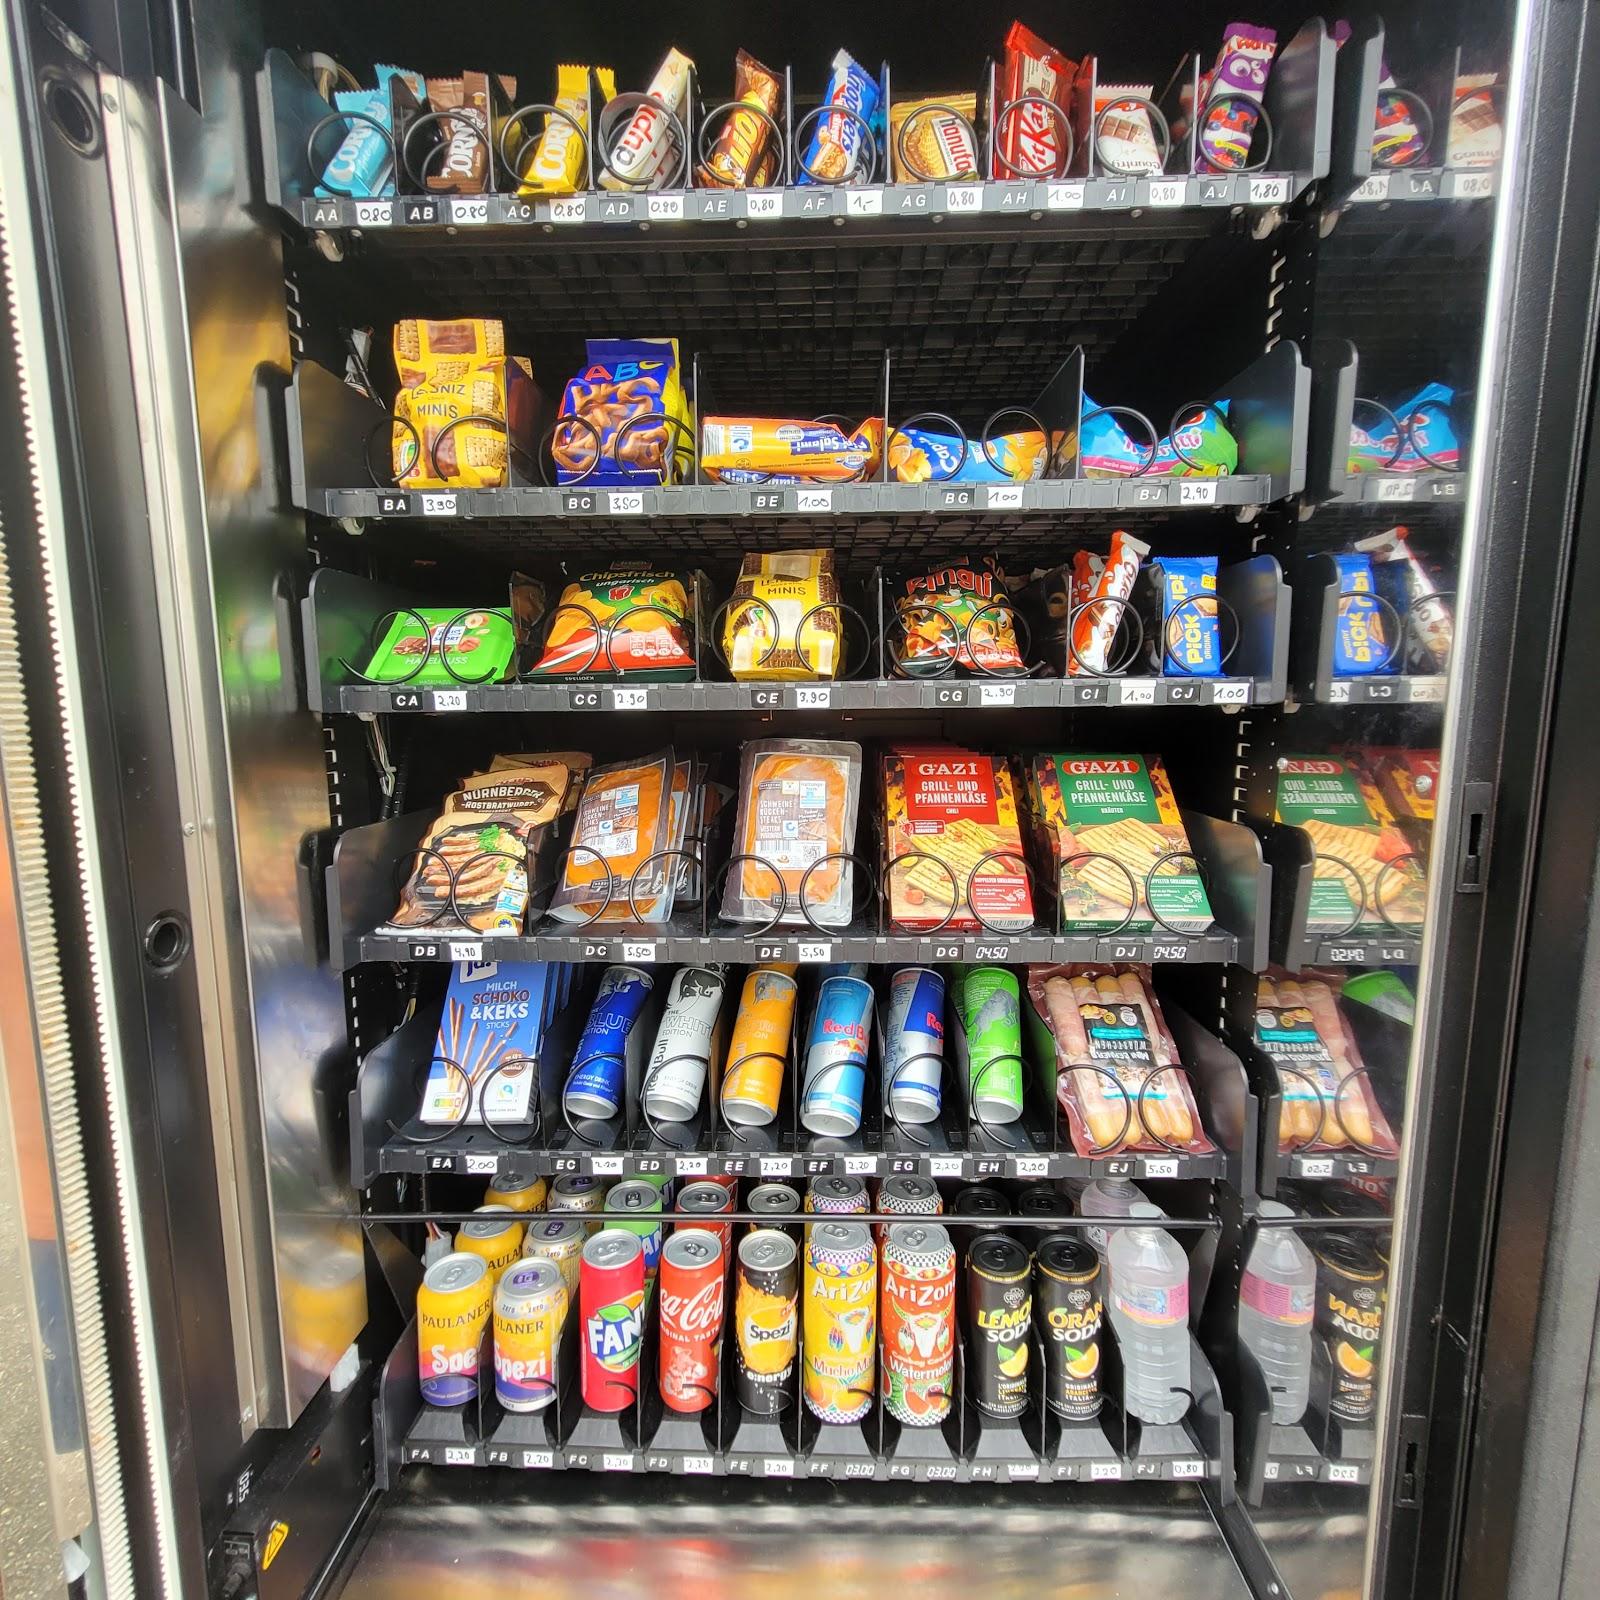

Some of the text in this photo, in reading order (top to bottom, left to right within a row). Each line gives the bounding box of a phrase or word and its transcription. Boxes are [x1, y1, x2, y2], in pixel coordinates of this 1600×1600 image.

[939, 116, 972, 173] hanuta
[1106, 189, 1127, 202] AI
[1204, 187, 1229, 200] AJ
[1251, 183, 1281, 199] 1,80
[902, 194, 927, 208] AG
[1002, 191, 1029, 205] AH
[605, 203, 629, 215] AD
[704, 200, 728, 213] AE
[803, 197, 827, 211] AF
[315, 209, 338, 221] AA
[410, 208, 434, 220] AB
[507, 206, 531, 218] AC
[584, 361, 665, 383] ABC
[416, 405, 458, 419] MINIS
[796, 436, 839, 451] Salami
[945, 492, 969, 504] BG
[1139, 489, 1162, 500] BJ
[384, 500, 406, 511] BA
[568, 499, 591, 510] BC
[756, 496, 779, 508] BE
[580, 571, 676, 582] Chipsfrisch
[596, 578, 655, 587] ungarisch
[767, 587, 807, 596] MINIS
[756, 692, 779, 704] CE
[939, 690, 963, 702] CG
[1081, 689, 1099, 699] CI
[1172, 688, 1194, 699] CJ
[396, 695, 418, 706] CA
[575, 694, 598, 705] CC
[921, 781, 979, 792] GRILL- UND
[1075, 780, 1135, 791] GRILL- UND
[915, 790, 988, 804] PFANNENKÄSE
[1071, 790, 1147, 804] PFANNENKÄSE
[415, 946, 437, 957] DB
[585, 946, 608, 957] DC
[760, 946, 783, 958] DE
[936, 946, 959, 957] DG
[1115, 947, 1137, 957] DJ
[485, 981, 518, 991] MILCH
[471, 989, 530, 1006] SCHOKO
[470, 1003, 529, 1021] &KEKS
[485, 1021, 510, 1030] STICKS
[822, 1018, 855, 1035] Red
[654, 1038, 669, 1067] Bull
[432, 1159, 453, 1170] EA
[555, 1160, 577, 1170] EC
[639, 1160, 661, 1171] ED
[724, 1161, 745, 1172] EE
[808, 1161, 829, 1172] EF
[893, 1162, 914, 1172] EG
[978, 1163, 1001, 1173] EH
[1108, 1163, 1129, 1174] EJ
[421, 1300, 491, 1329] PAULANER
[749, 1319, 791, 1342] Spezi
[411, 1451, 430, 1460] FA
[489, 1452, 508, 1462] FB
[569, 1455, 588, 1465] FC
[649, 1458, 668, 1468] FD
[729, 1460, 749, 1471] FE
[810, 1463, 829, 1473] FF
[890, 1466, 910, 1476] FG
[972, 1467, 992, 1477] FH
[1057, 1466, 1073, 1476] FI
[1137, 1464, 1156, 1474] FJ
